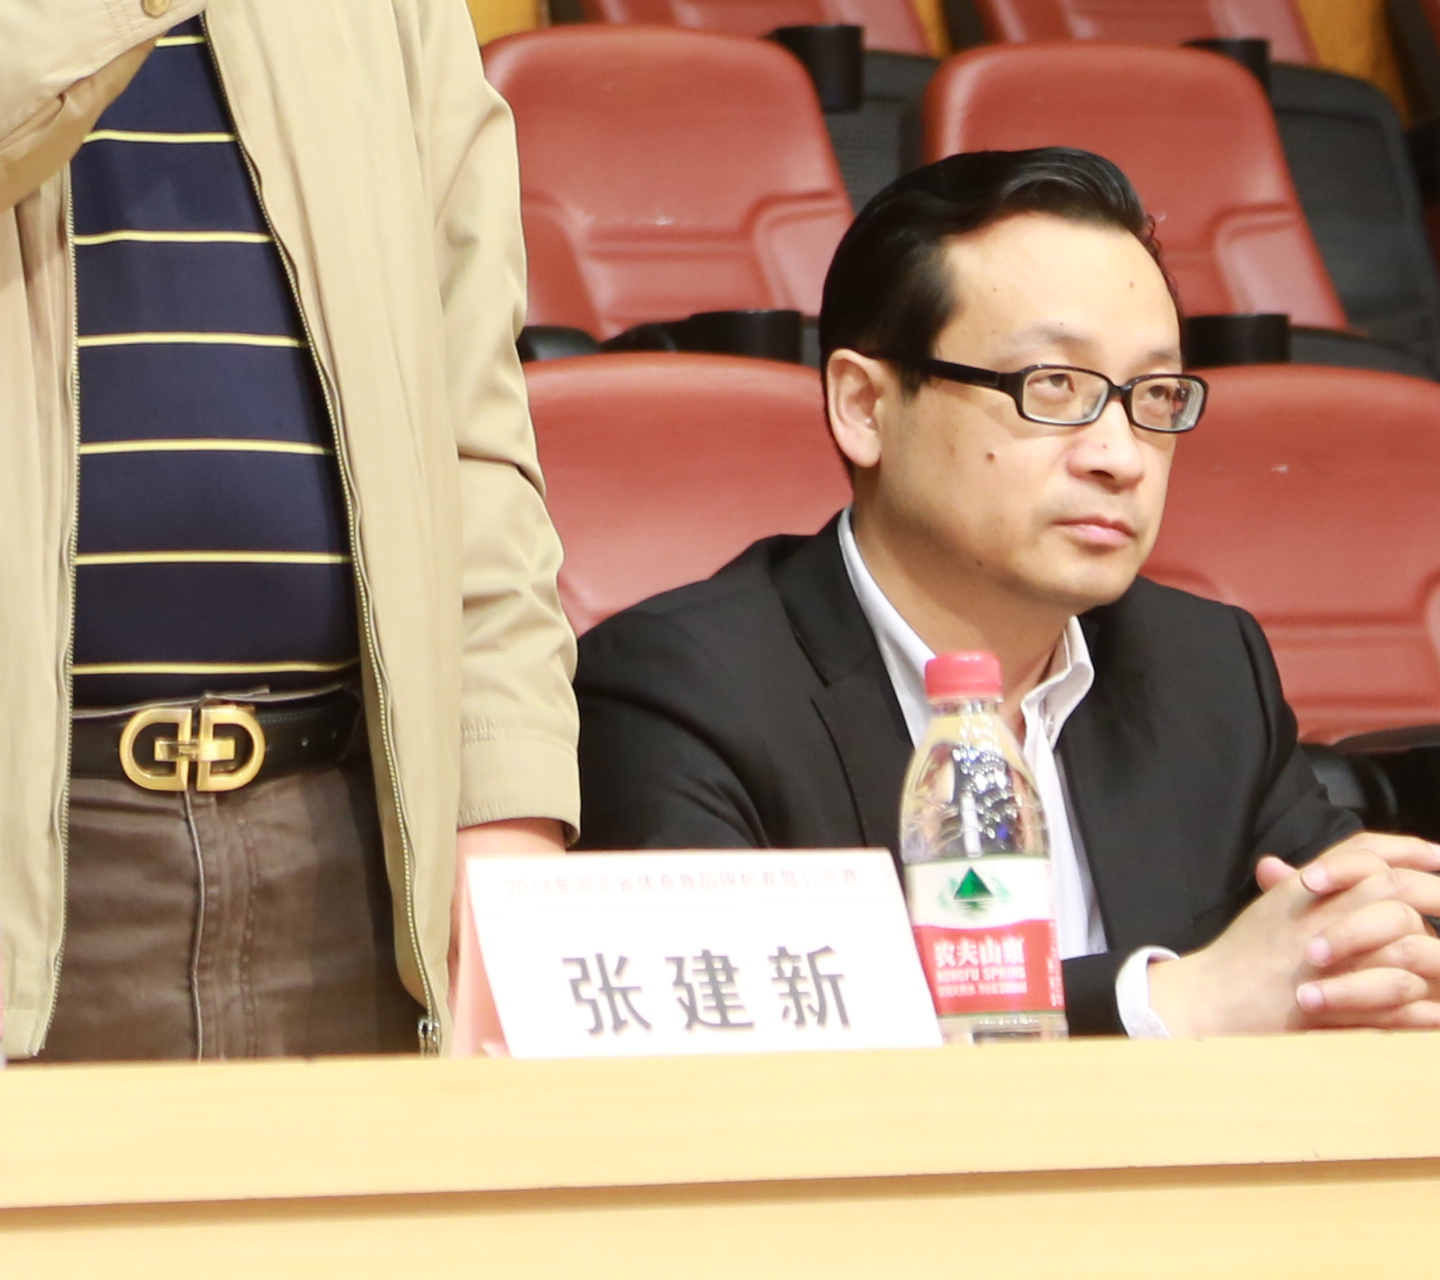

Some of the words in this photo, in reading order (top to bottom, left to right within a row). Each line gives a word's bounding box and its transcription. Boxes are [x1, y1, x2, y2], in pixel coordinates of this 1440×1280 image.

[934, 935, 1027, 968] 农夫山泉
[561, 945, 851, 1035] 张建新
